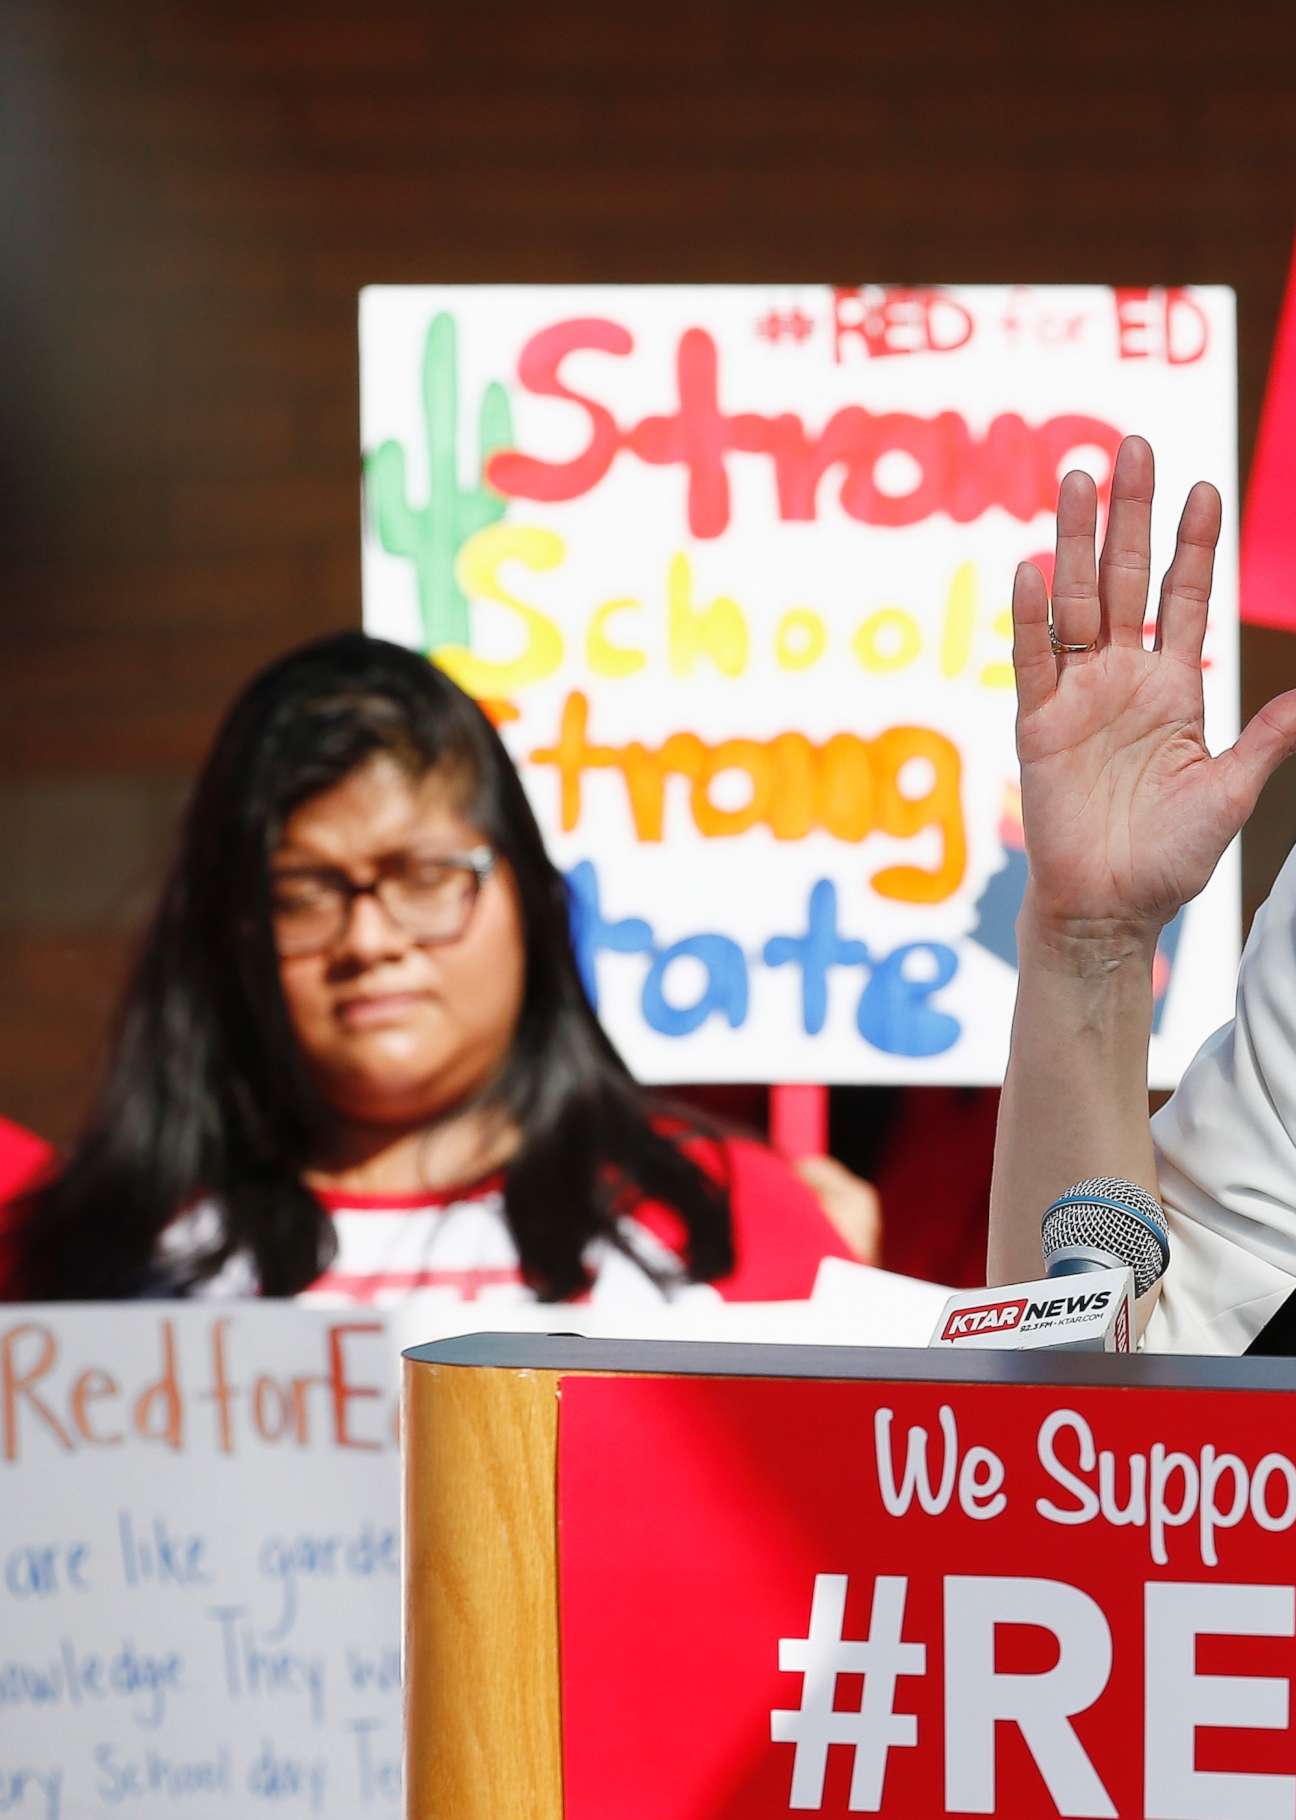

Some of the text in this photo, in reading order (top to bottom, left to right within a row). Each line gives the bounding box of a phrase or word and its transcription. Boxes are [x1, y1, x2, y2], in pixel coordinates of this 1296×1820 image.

[476, 690, 967, 904] trong
[565, 860, 960, 1058] tate
[948, 1291, 1112, 1335] KTAR NEWS
[1058, 1312, 1104, 1326] KTAR.COM
[0, 1316, 399, 1462] RedforE
[874, 1404, 1005, 1519] We
[4, 1507, 400, 1640] are like garde
[208, 1606, 328, 1725] They
[95, 1742, 232, 1802] School
[250, 1735, 328, 1815] day
